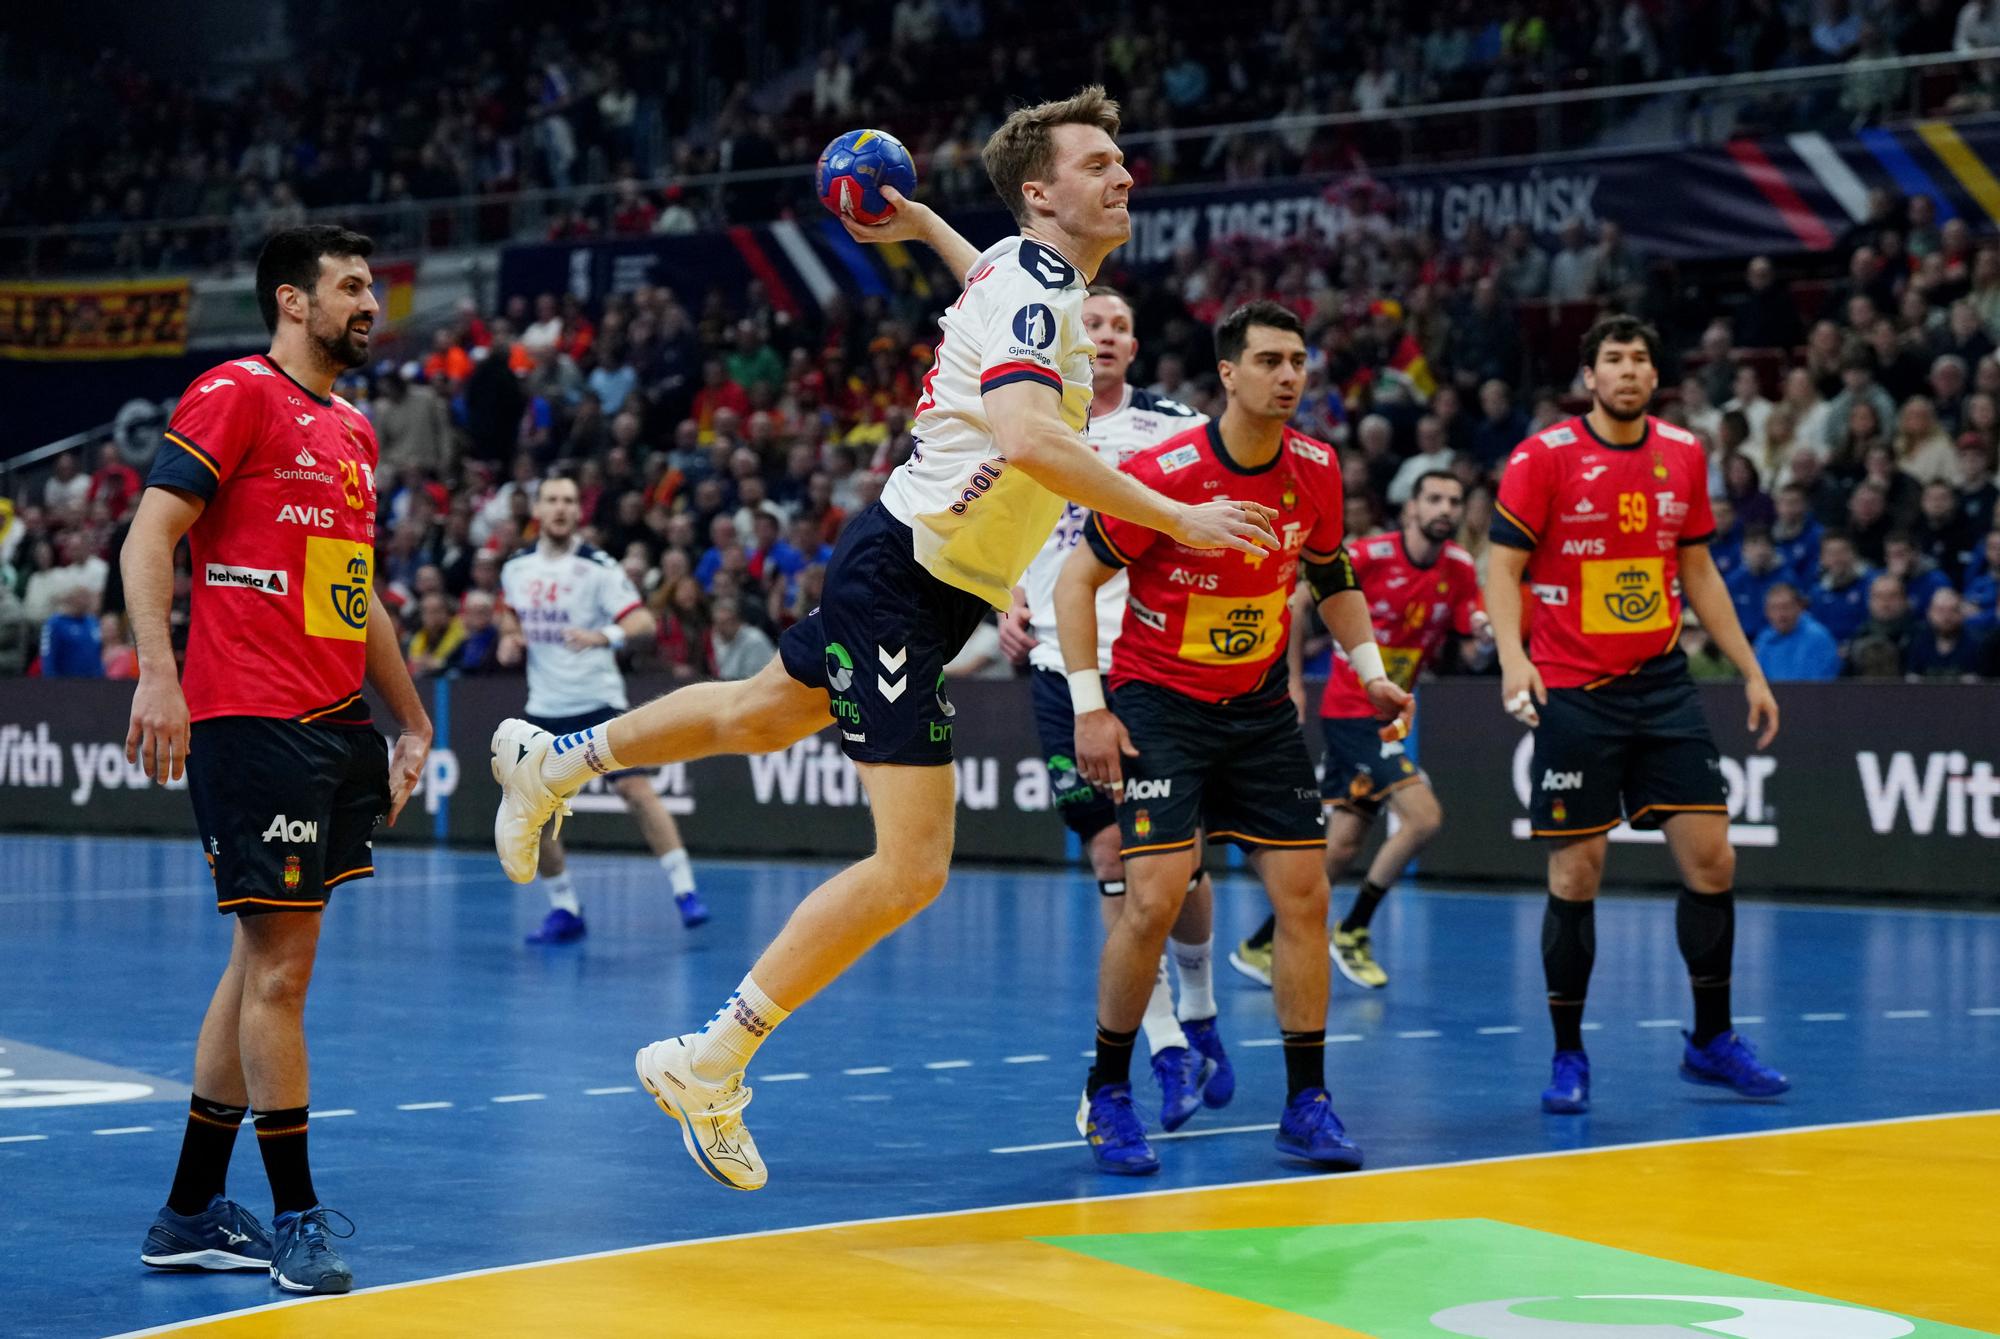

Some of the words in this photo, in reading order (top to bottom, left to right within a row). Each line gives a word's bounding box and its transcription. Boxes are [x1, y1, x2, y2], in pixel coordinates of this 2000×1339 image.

[273, 467, 334, 484] Santander
[275, 504, 335, 529] AVIS
[1617, 491, 1648, 533] 59
[1561, 538, 1606, 555] AVIS
[207, 569, 264, 588] helvetia
[1168, 567, 1218, 591] AVIS
